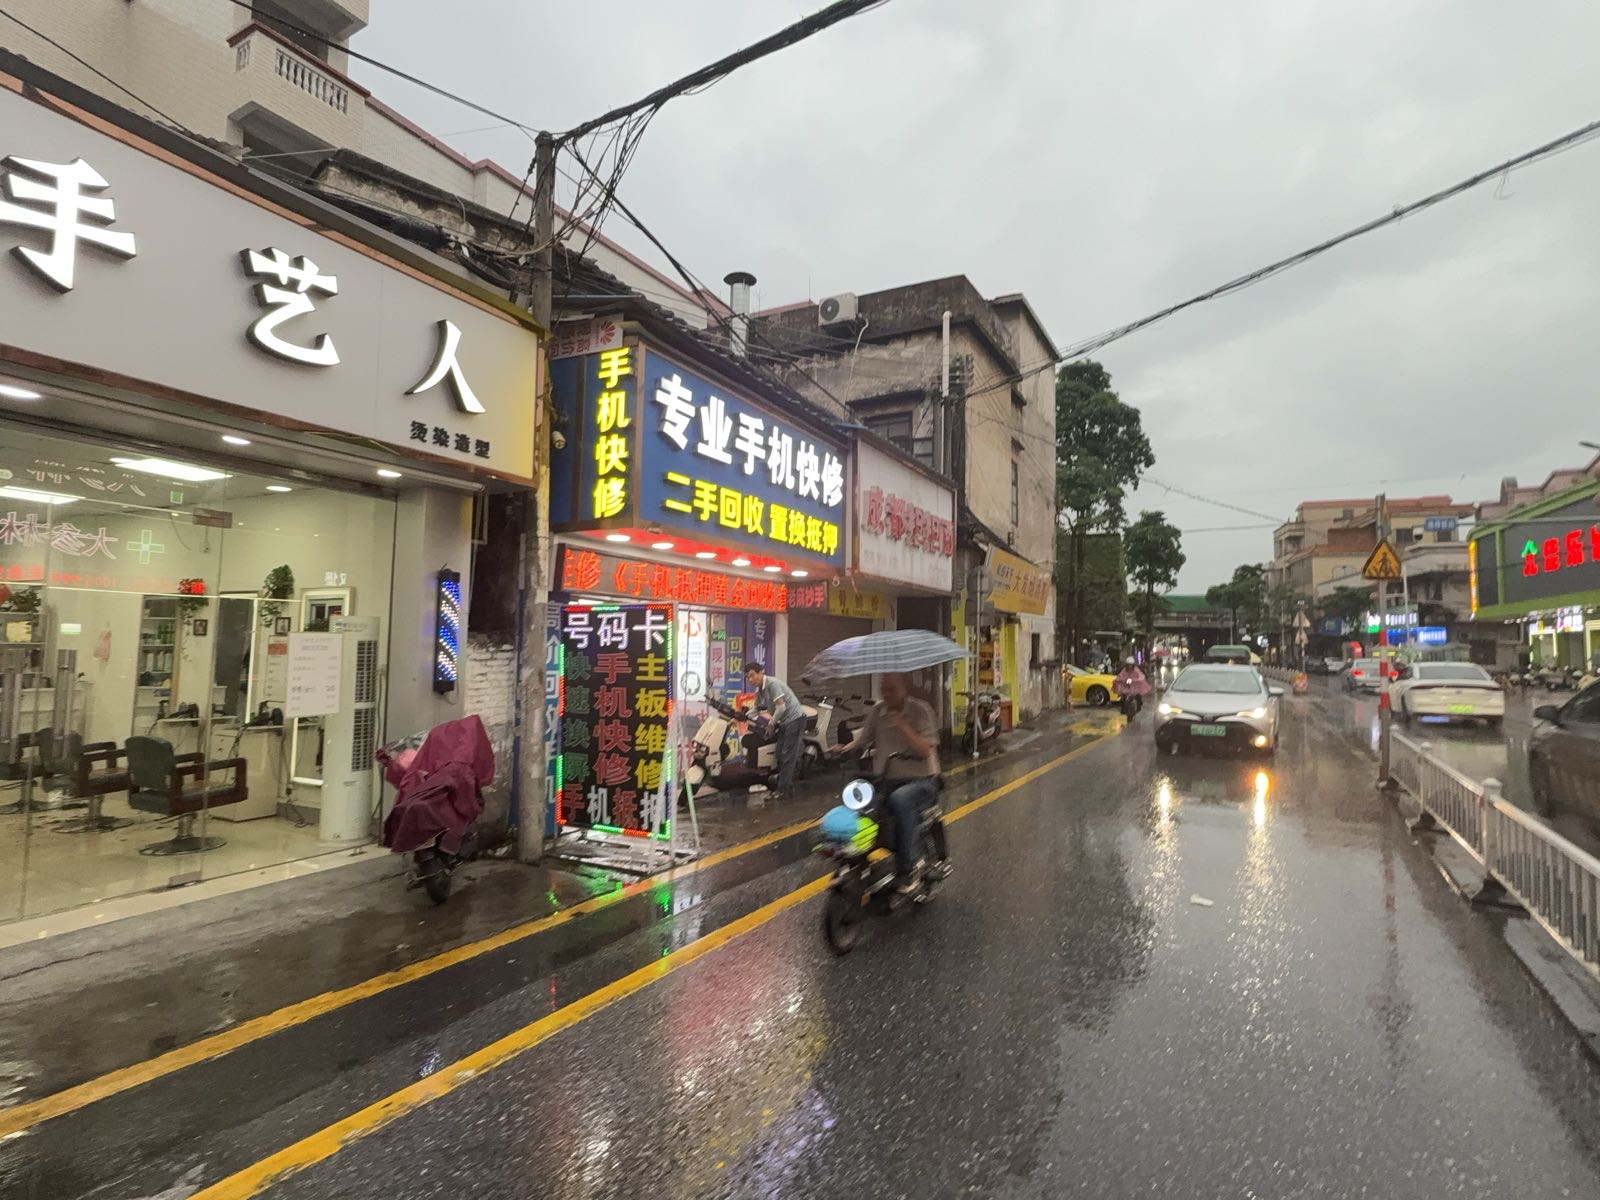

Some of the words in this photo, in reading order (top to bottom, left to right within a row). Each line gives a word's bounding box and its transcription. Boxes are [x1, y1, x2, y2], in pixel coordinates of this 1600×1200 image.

[0, 154, 486, 414] 手艺人
[410, 420, 491, 459] 烫染造型
[593, 346, 632, 519] 手机快修
[655, 374, 844, 507] 专业手机快修
[665, 471, 764, 537] 二手回收
[769, 503, 839, 556] 置换抵押
[564, 609, 667, 651] 号码卡
[563, 651, 592, 784] 快速换屏
[593, 651, 632, 786] 手机快修
[634, 652, 668, 790] 主板维修
[562, 783, 666, 831] 手机抵押
